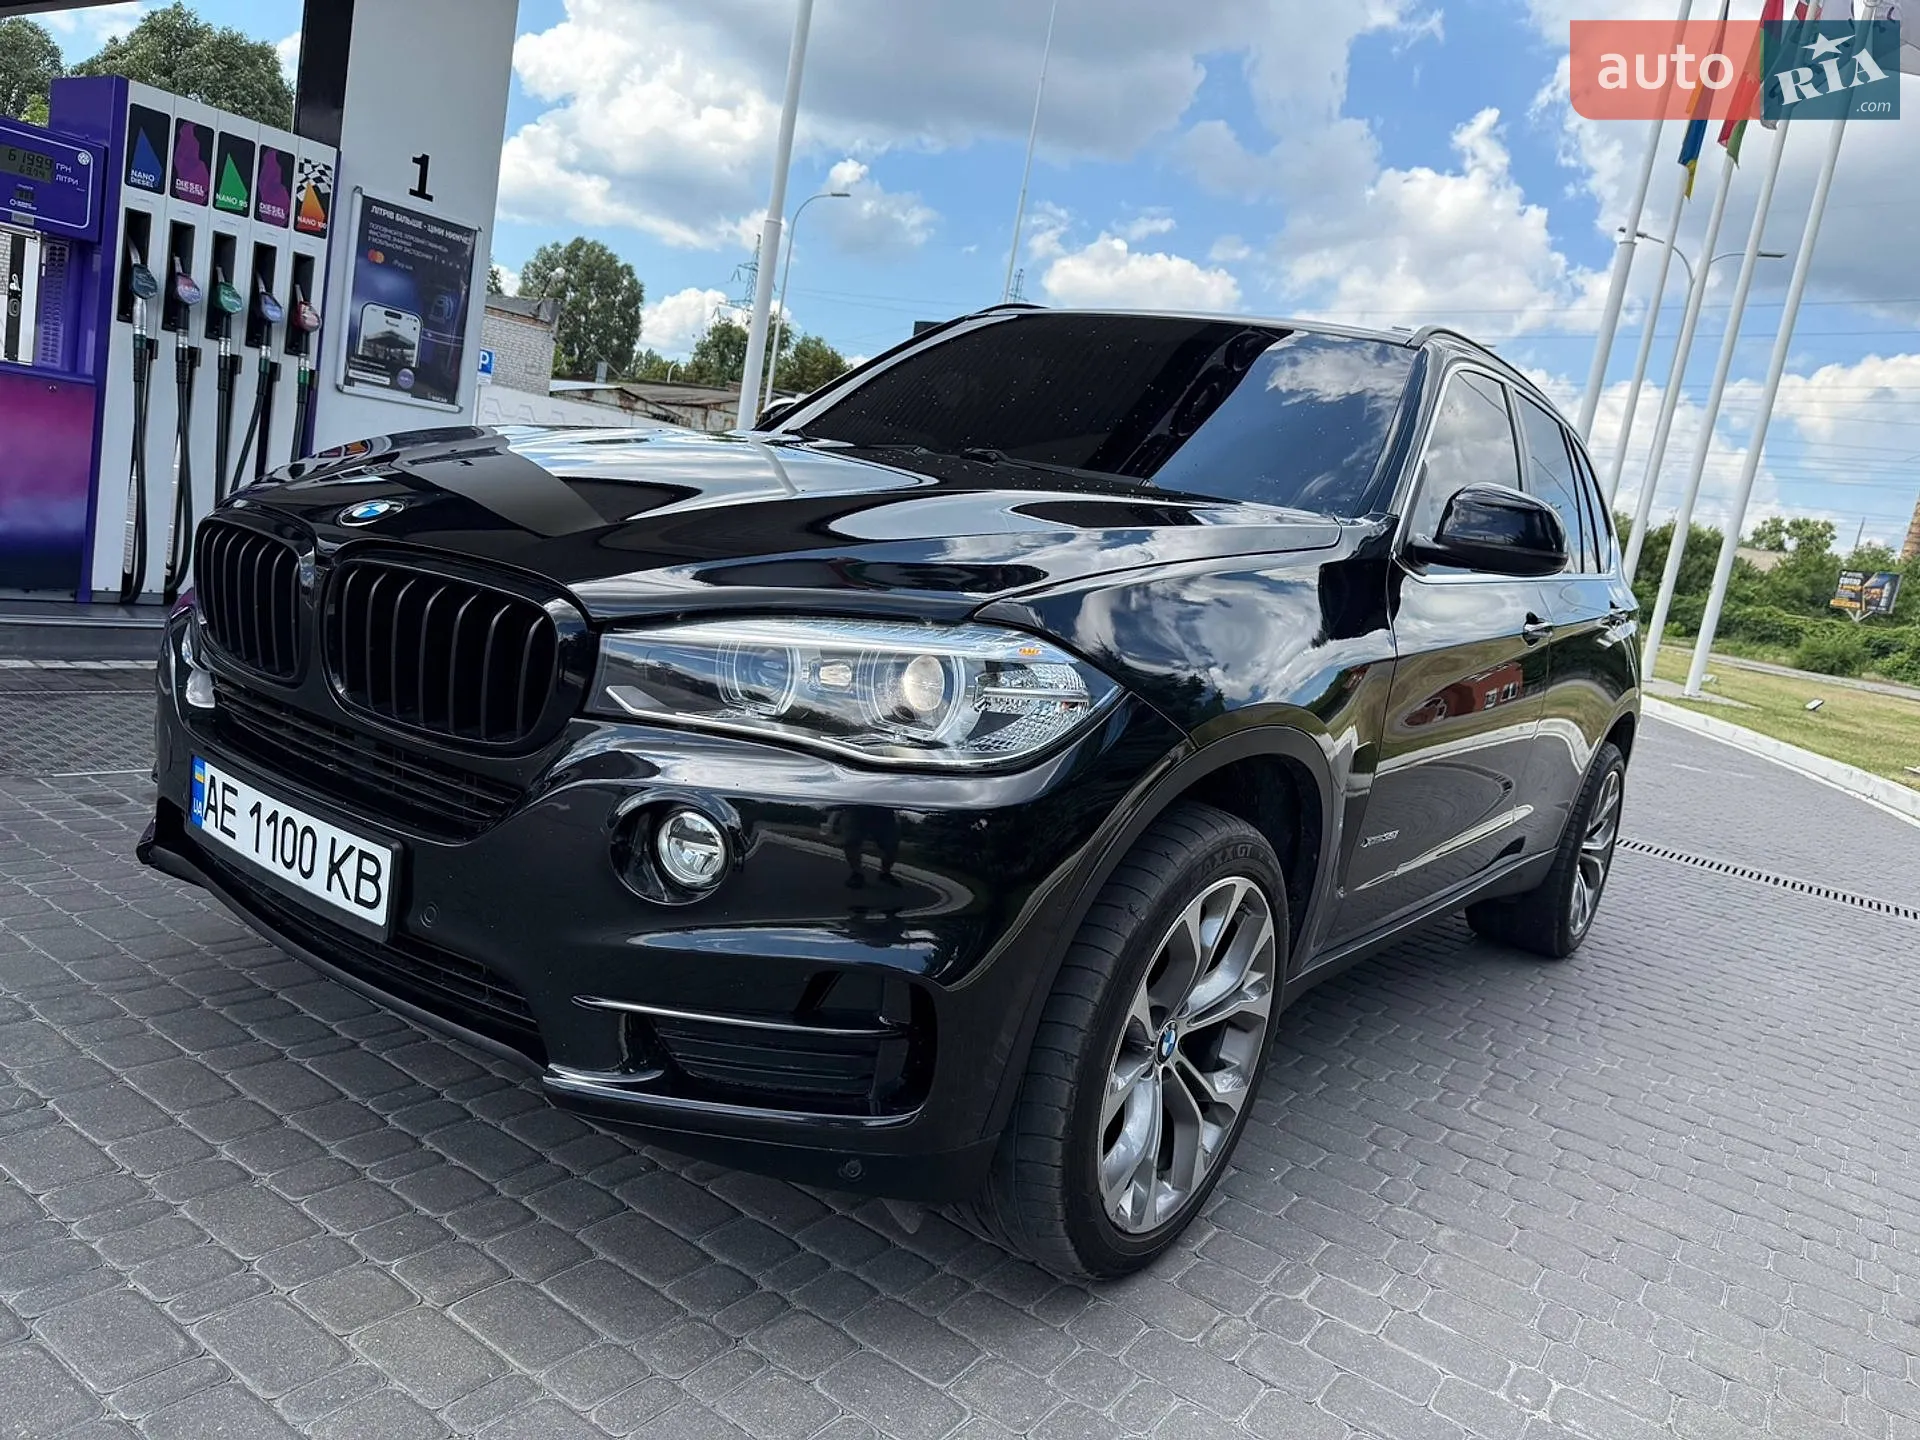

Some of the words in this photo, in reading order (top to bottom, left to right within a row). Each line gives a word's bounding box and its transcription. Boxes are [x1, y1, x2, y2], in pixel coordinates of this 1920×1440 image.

[55, 162, 72, 174] ГРН
[55, 174, 79, 186] ЛІТРИ
[130, 169, 155, 182] NANO
[130, 176, 153, 188] DIESEL
[408, 153, 434, 202] 1
[175, 178, 205, 192] DIESEL
[215, 193, 238, 205] NANO
[259, 202, 285, 216] DIESEL
[297, 215, 316, 227] NANO
[479, 350, 490, 370] P
[204, 774, 238, 840] AE
[249, 801, 317, 880] 1100
[326, 837, 382, 910] KB
